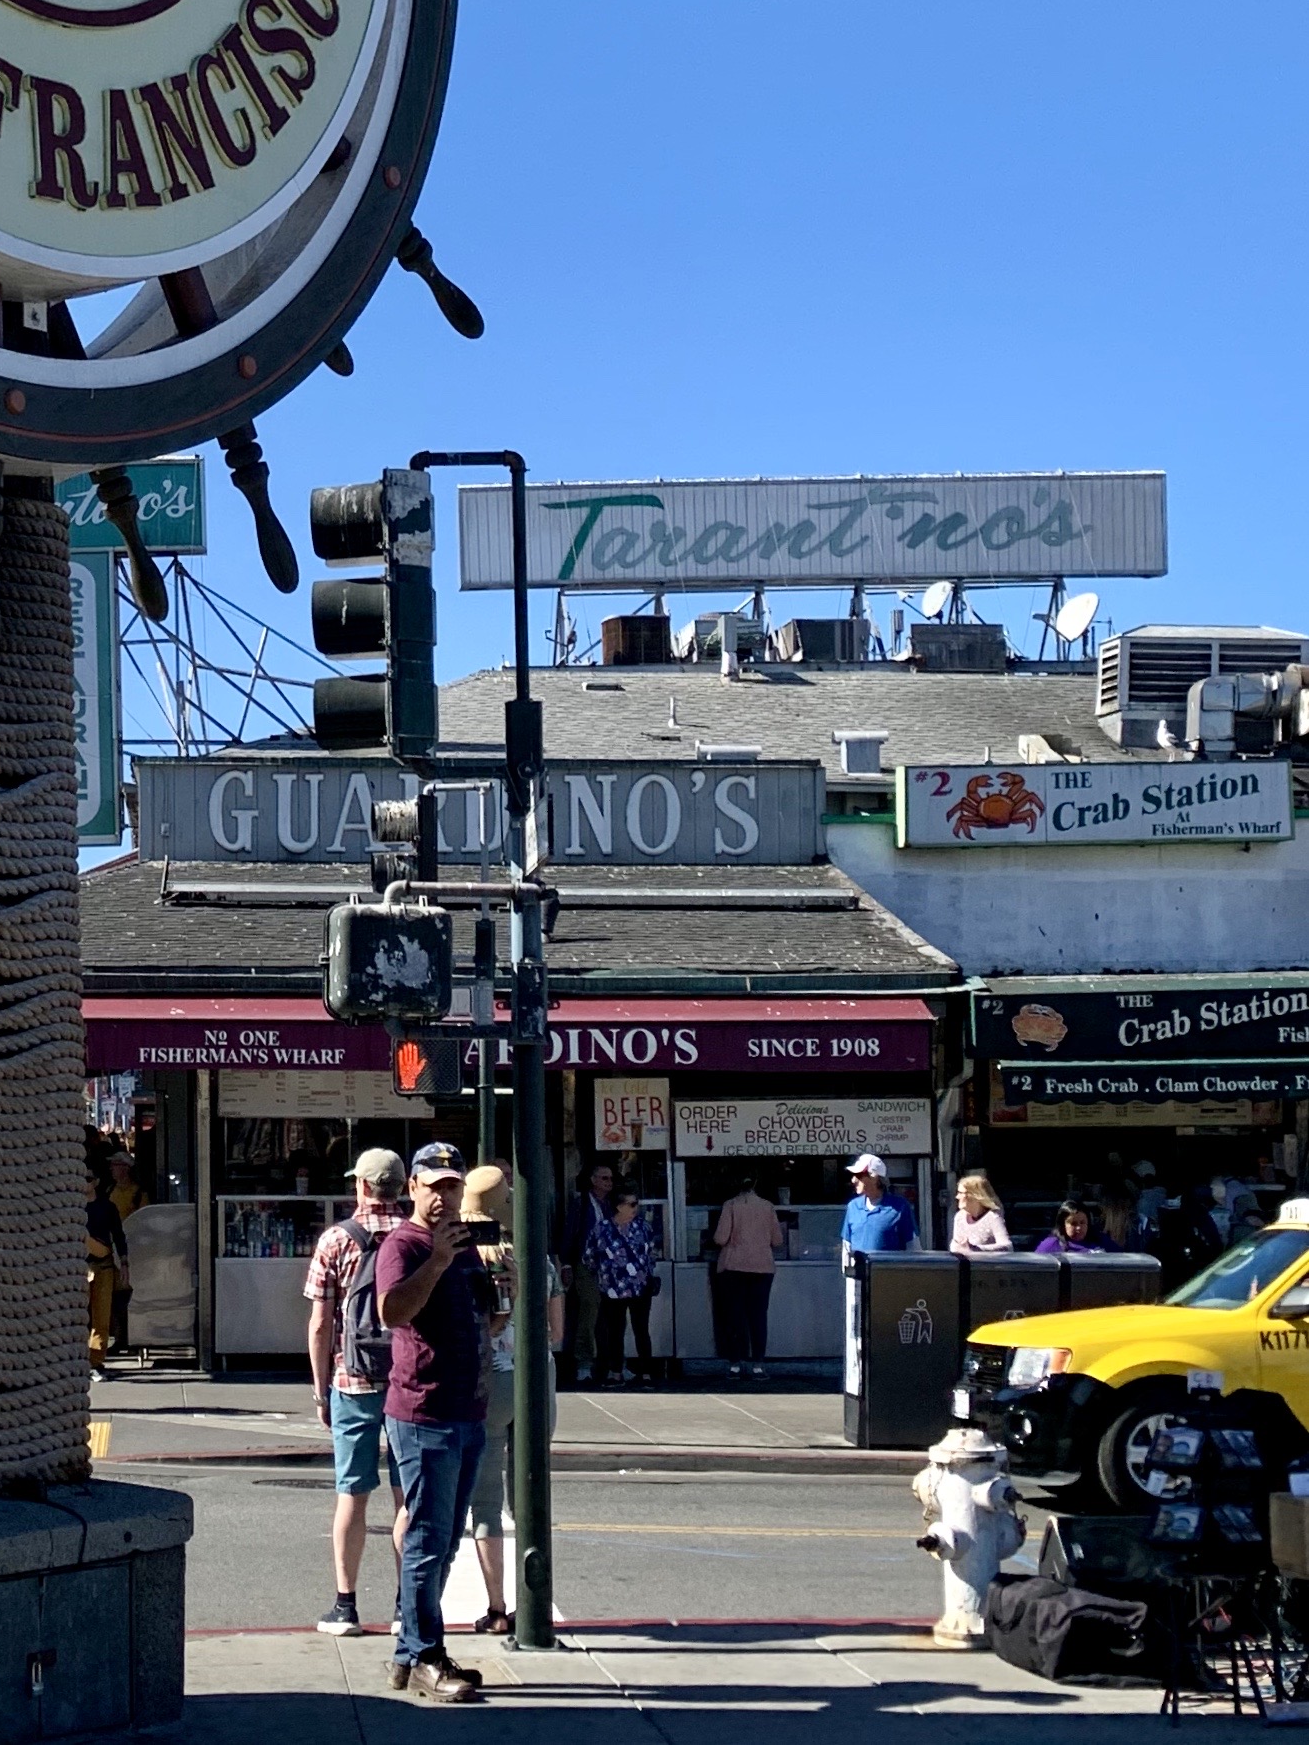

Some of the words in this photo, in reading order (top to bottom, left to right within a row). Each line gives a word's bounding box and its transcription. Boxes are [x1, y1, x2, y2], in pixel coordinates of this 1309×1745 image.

[541, 487, 1092, 580] Tarantno's
[914, 770, 953, 797] #2
[1051, 771, 1092, 790] THE
[1052, 793, 1130, 832] Crab
[1141, 772, 1261, 816] Station
[208, 769, 760, 855] GUADNO'S
[1175, 811, 1191, 824] At
[1152, 821, 1234, 836] Fisherman's
[1239, 821, 1282, 834] Wharf
[1116, 995, 1154, 1008] THE
[1118, 1009, 1191, 1047] Crab
[1200, 991, 1309, 1031] Station
[239, 1030, 280, 1046] ONE
[747, 1039, 821, 1058] SINCE
[829, 1037, 881, 1057] 1908
[139, 1048, 269, 1065] FISHERMAN'S
[273, 1048, 346, 1065] WHARF
[1012, 1076, 1033, 1091] #2
[1046, 1078, 1093, 1094] Fresh
[1097, 1078, 1139, 1093] Crab
[1155, 1078, 1199, 1093] Clam
[1203, 1076, 1279, 1092] Chowder
[604, 1096, 665, 1126] BEER
[679, 1105, 738, 1121] ORDER
[775, 1102, 830, 1117] Delicious
[857, 1101, 926, 1113] SANDWICH
[686, 1120, 732, 1134] HERE
[758, 1115, 845, 1130] CHOWDER
[872, 1116, 911, 1124] LOBSTER
[745, 1129, 801, 1144] BREAD
[806, 1129, 867, 1143] BOWLS
[747, 1145, 784, 1156] COLD
[786, 1144, 819, 1155] BEER
[824, 1144, 851, 1155] AND
[855, 1143, 892, 1155] SODA
